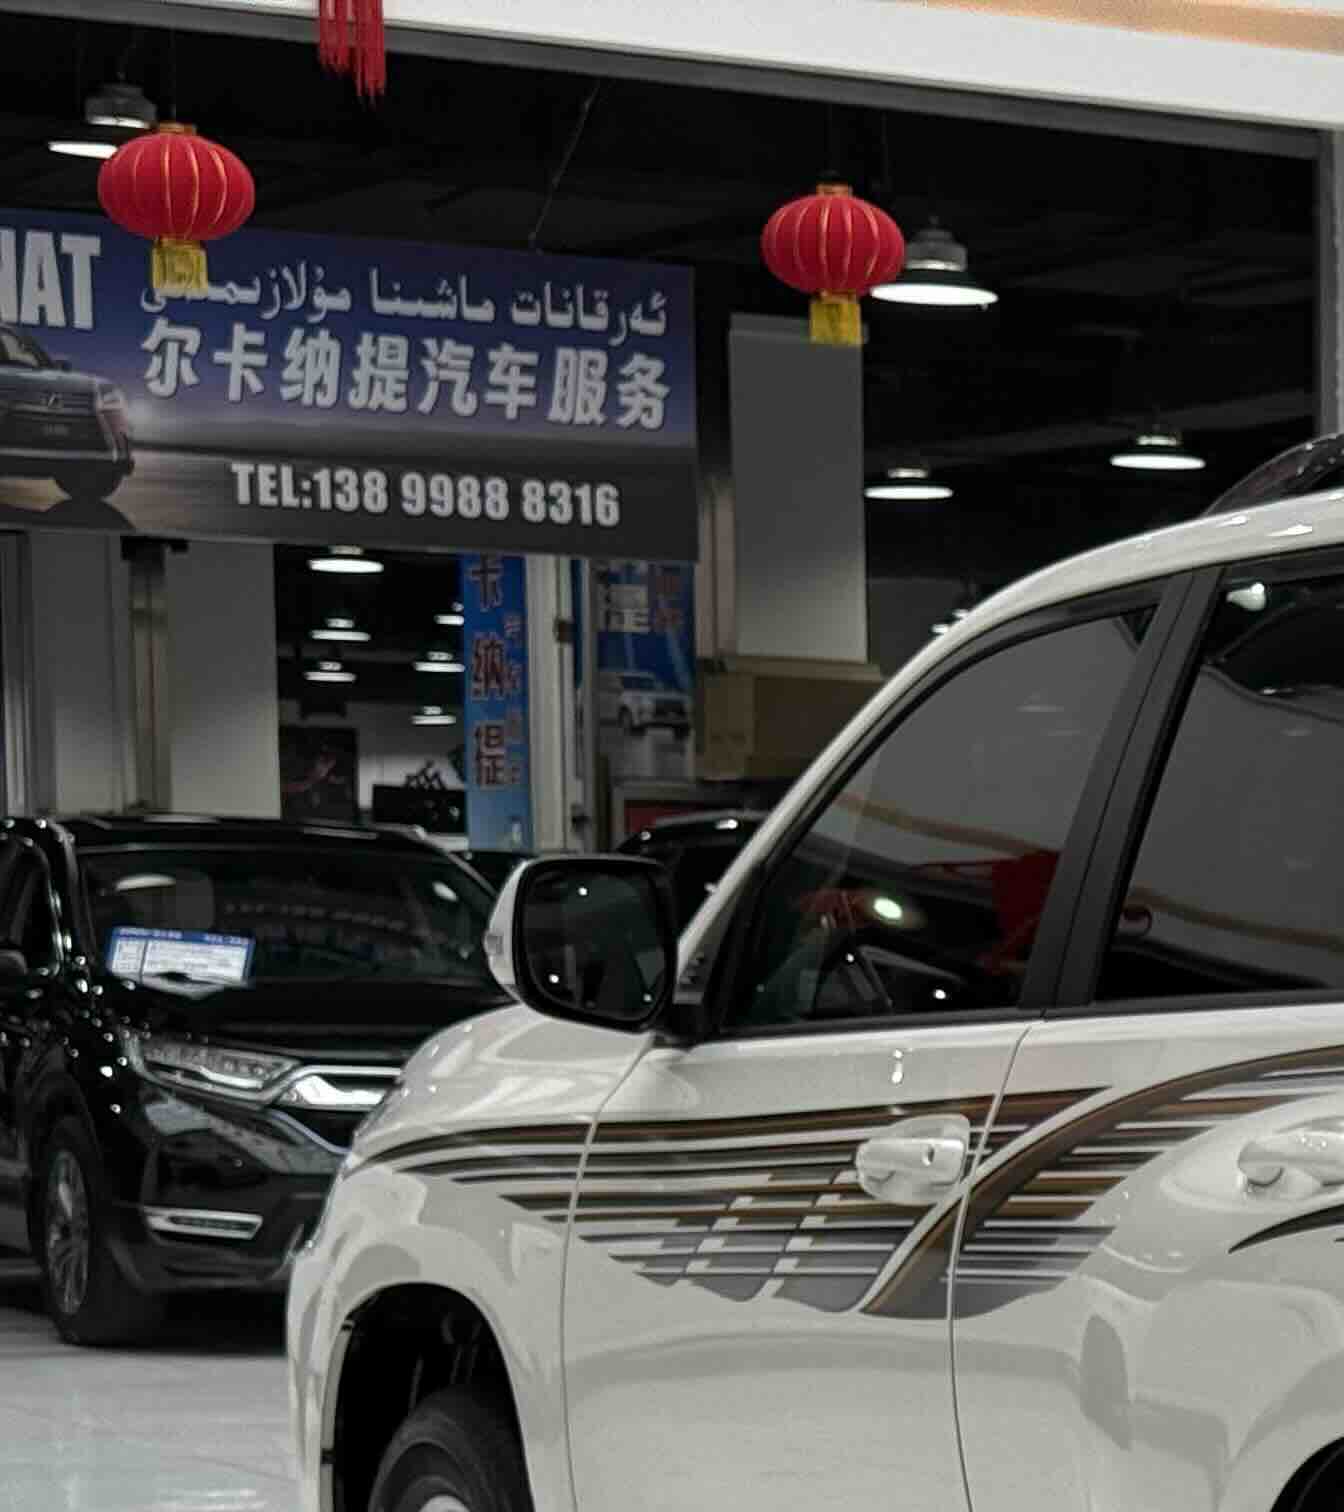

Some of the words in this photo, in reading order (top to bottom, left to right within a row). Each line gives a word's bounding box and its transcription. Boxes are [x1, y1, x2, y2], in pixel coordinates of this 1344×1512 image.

[141, 316, 671, 430] 尔卡纳提汽车服务
[231, 462, 389, 514] TEL:138
[401, 472, 510, 521] 9988
[522, 480, 620, 527] 8316
